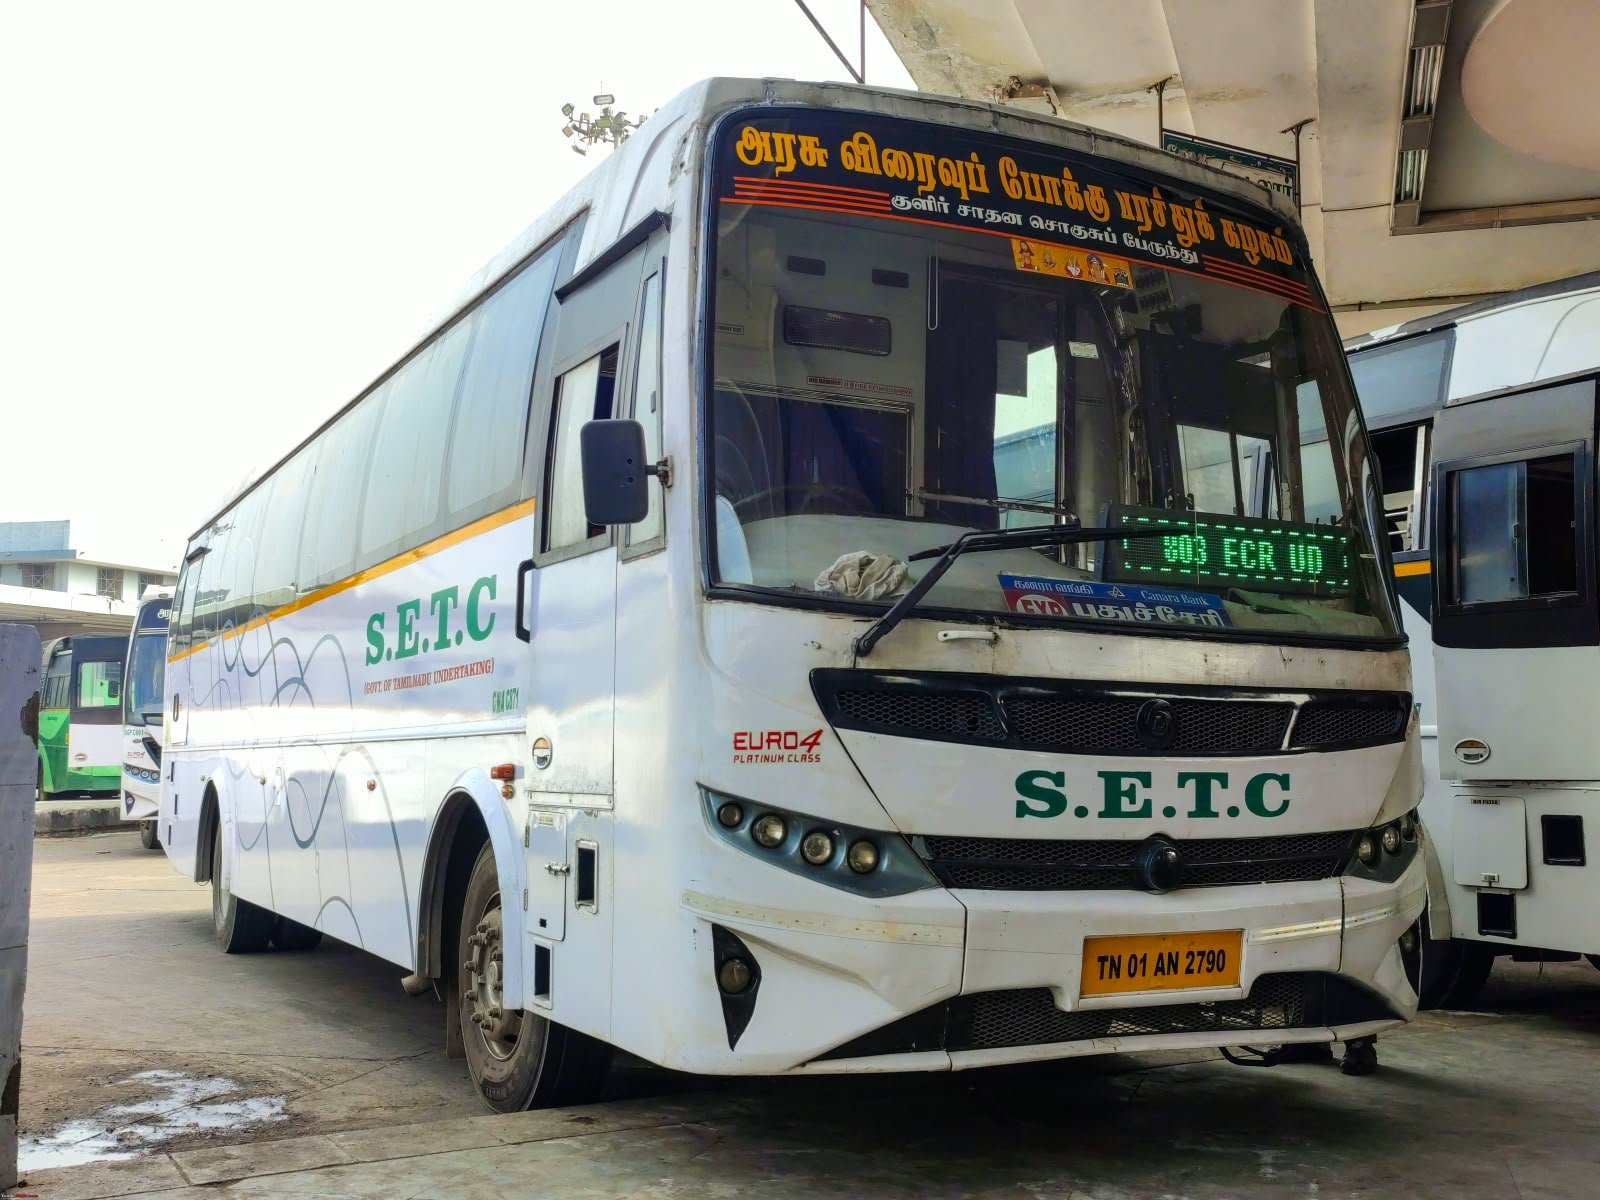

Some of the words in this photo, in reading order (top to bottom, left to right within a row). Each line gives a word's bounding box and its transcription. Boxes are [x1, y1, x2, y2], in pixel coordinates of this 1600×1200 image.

[736, 126, 828, 177] அரசு
[840, 132, 990, 200] விரைவுப்
[999, 157, 1111, 221] போக்கு
[1220, 226, 1293, 266] கழகம்
[891, 195, 950, 214] குளிர்
[957, 204, 1023, 226] சாதன
[1029, 215, 1118, 245] சொகுசுப்
[1122, 232, 1199, 264] பேருந்து
[1223, 538, 1277, 571] ECR
[1289, 544, 1324, 575] UD
[1013, 579, 1052, 593] கனரா
[1055, 582, 1094, 596] வங்கி
[1140, 589, 1180, 604] Canara
[1182, 593, 1211, 607] Bank
[365, 574, 497, 666] S.E.T.C
[383, 679, 392, 692] OF
[392, 672, 432, 690] TAMILNADU
[433, 657, 495, 684] UNDERTAKING)
[733, 729, 824, 753] EURO4
[733, 754, 784, 763] PLATINUM
[787, 754, 821, 763] CLASS
[1015, 770, 1290, 818] S.E.T.C
[1097, 955, 1122, 980] TN
[1127, 953, 1147, 978] 01
[1154, 951, 1180, 976] AN
[1185, 949, 1226, 974] 2790
